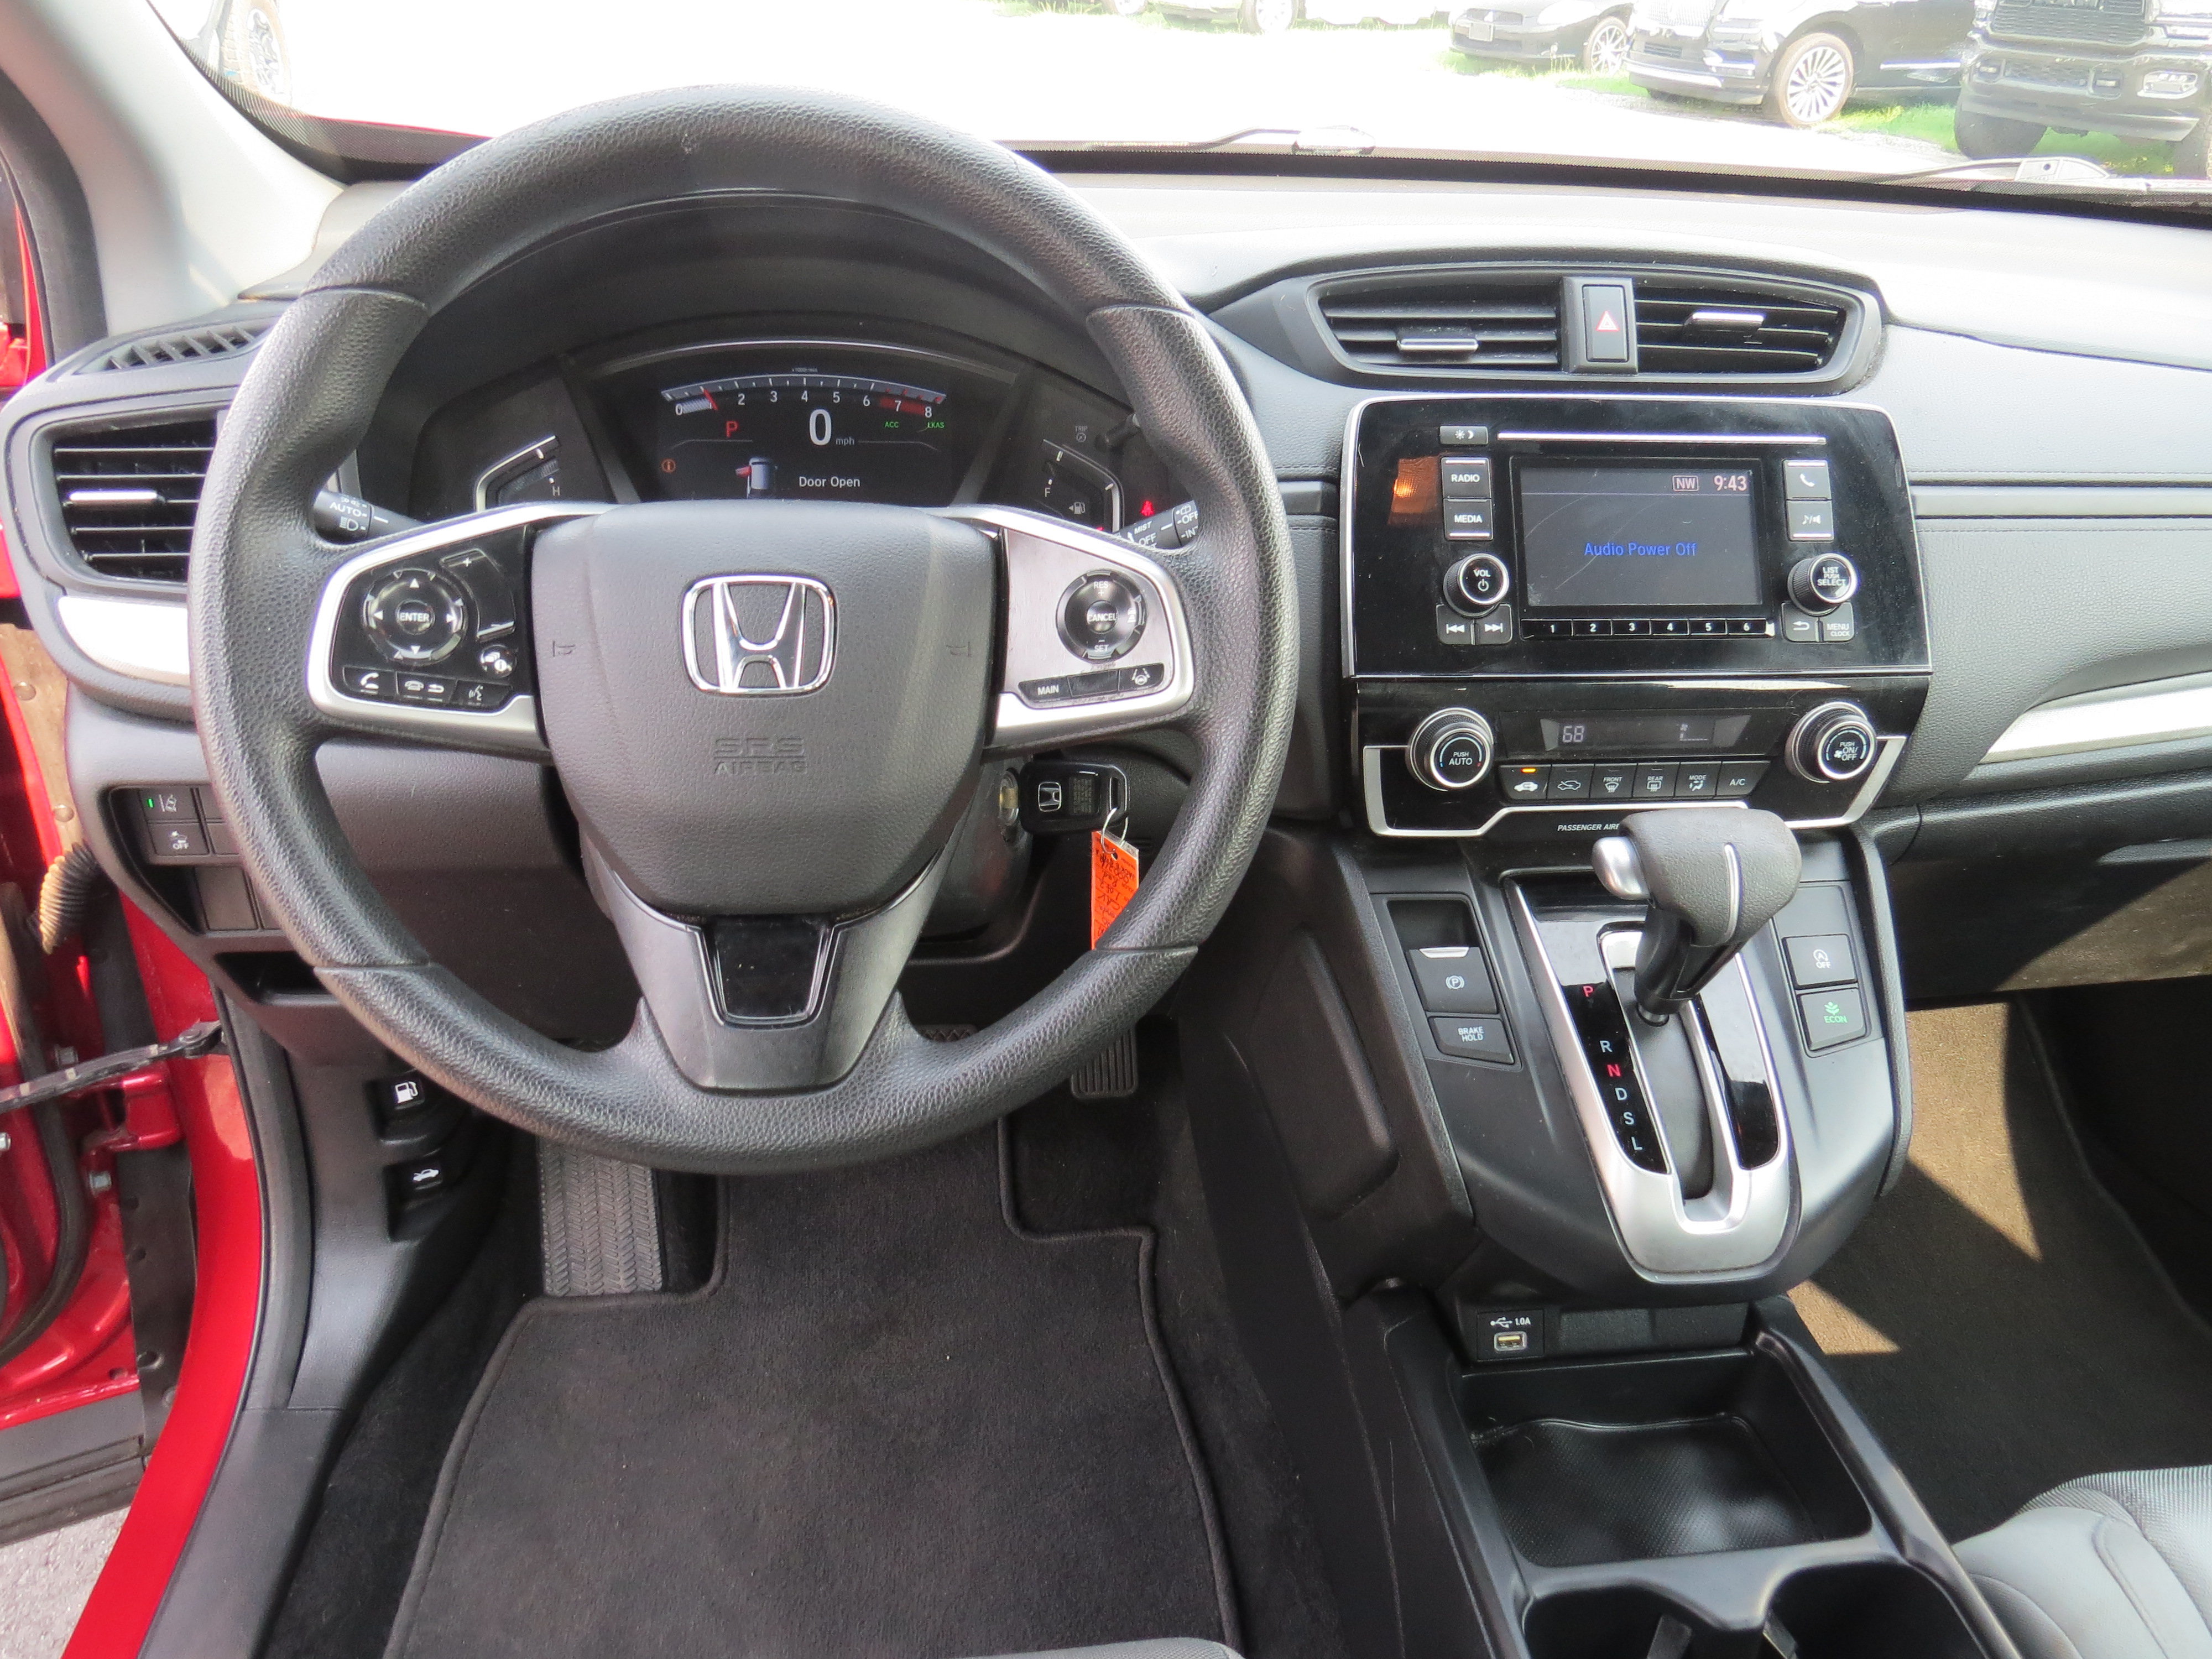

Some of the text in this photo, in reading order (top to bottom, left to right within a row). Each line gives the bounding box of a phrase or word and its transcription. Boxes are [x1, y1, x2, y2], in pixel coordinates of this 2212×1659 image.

[738, 393, 745, 405] 2
[770, 390, 778, 402] 3
[801, 390, 808, 403] 4
[833, 391, 840, 403] 5
[863, 395, 870, 406] 6
[894, 400, 901, 412] 7
[925, 406, 932, 418] 8
[726, 420, 738, 438] P
[809, 408, 832, 446] 0
[836, 436, 855, 446] mph
[799, 476, 860, 490] Door Open
[1451, 473, 1480, 483] RADIO
[1676, 478, 1695, 489] NW
[1714, 475, 1747, 491] 9:43
[552, 486, 560, 496] H
[1045, 488, 1051, 497] F
[329, 502, 362, 517] AUTO
[1454, 514, 1483, 524] MEDIA
[1134, 520, 1152, 535] MIST
[1138, 532, 1157, 546] OFF
[1584, 541, 1697, 556] Audio Power Off
[1473, 569, 1491, 577] VOL
[1093, 581, 1109, 589] RES
[399, 612, 430, 622] ENTER
[1087, 613, 1117, 622] CANCEL
[1551, 622, 1750, 633] 1 2 3 4 5 6
[1037, 685, 1059, 696] MAIN
[1562, 725, 1585, 743] 68
[1448, 757, 1473, 766] AUTO
[1729, 778, 1746, 787] A/C
[1583, 986, 1594, 997] P
[1458, 1026, 1484, 1035] BRAKE
[1462, 1034, 1484, 1042] HOLD
[1600, 1040, 1613, 1053] R
[1606, 1063, 1621, 1077] N
[1615, 1087, 1627, 1101] D
[1623, 1112, 1635, 1125] S
[1631, 1136, 1643, 1151] L
[1515, 1317, 1531, 1326] 1.0A
